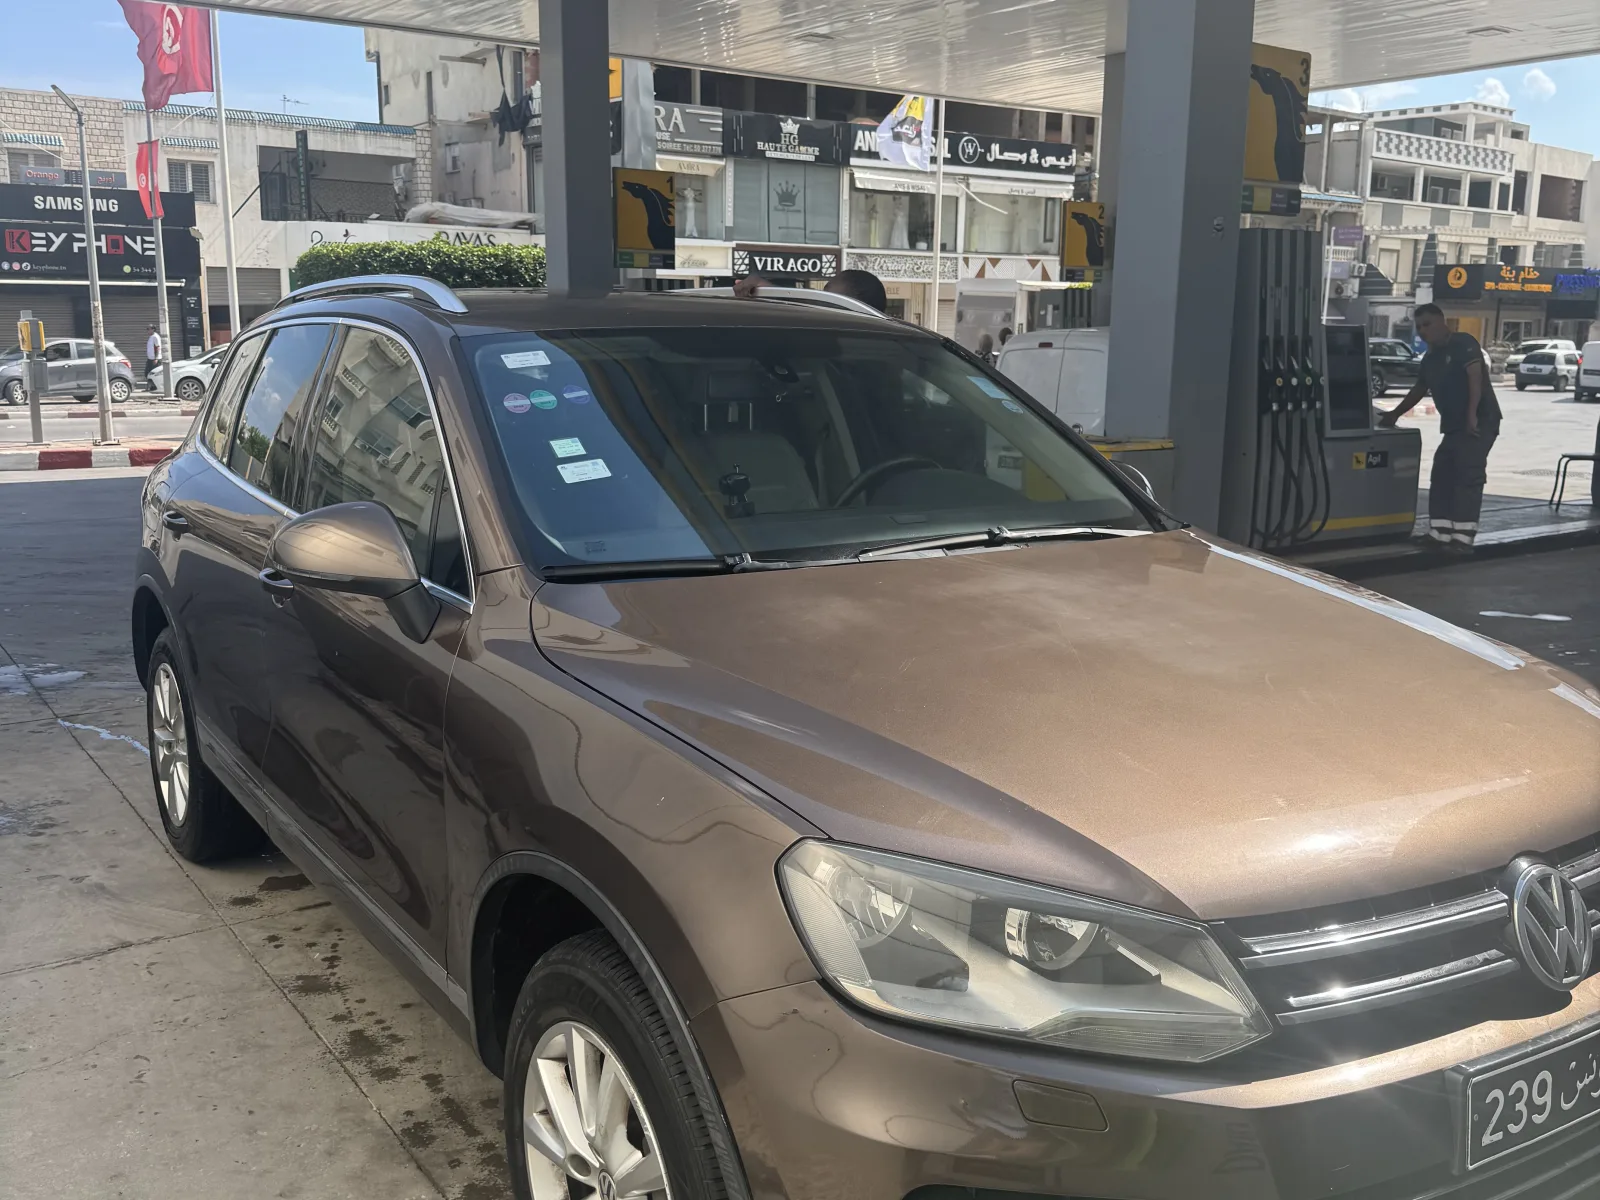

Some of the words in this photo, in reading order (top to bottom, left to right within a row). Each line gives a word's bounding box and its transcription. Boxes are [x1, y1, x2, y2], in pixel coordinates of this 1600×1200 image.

[780, 133, 799, 146] HG
[756, 141, 787, 153] HAUTE
[788, 144, 820, 156] GAMME
[1029, 148, 1039, 164] &
[666, 176, 674, 194] 1
[1098, 205, 1104, 219] 2
[5, 229, 68, 254] KEY
[753, 256, 821, 273] VIRAGO
[1481, 1070, 1553, 1147] 239
